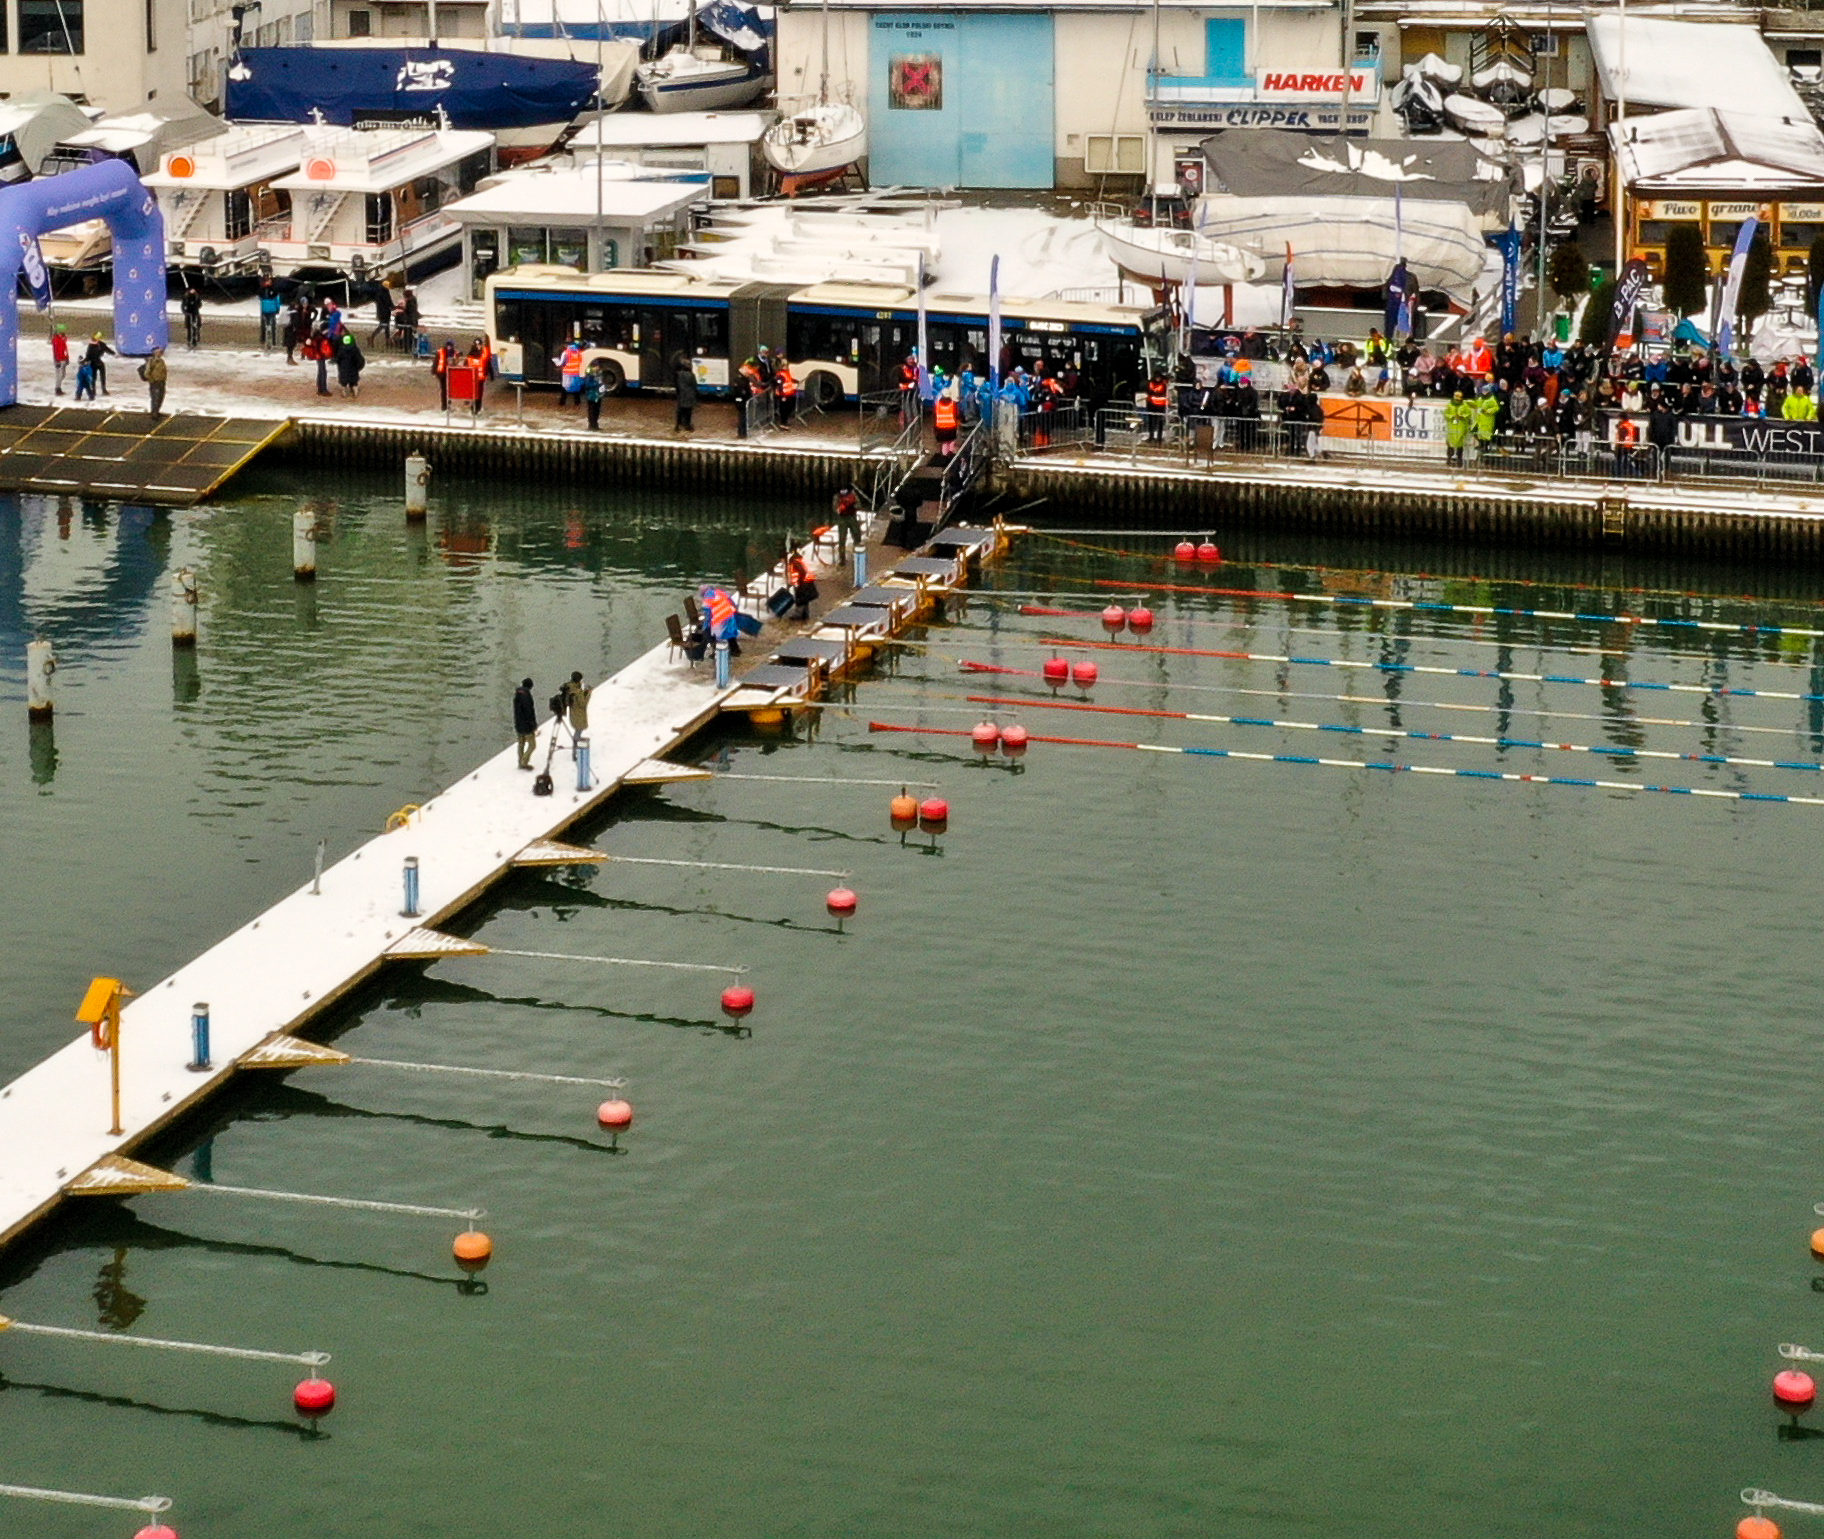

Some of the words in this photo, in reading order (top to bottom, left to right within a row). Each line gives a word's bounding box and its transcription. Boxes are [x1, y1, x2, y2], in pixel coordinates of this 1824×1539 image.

[1263, 74, 1364, 92] HARKEN
[1226, 110, 1311, 127] CLIPPER
[1318, 114, 1340, 124] YACH
[1393, 406, 1429, 430] BCT
[1743, 427, 1821, 454] WEST
